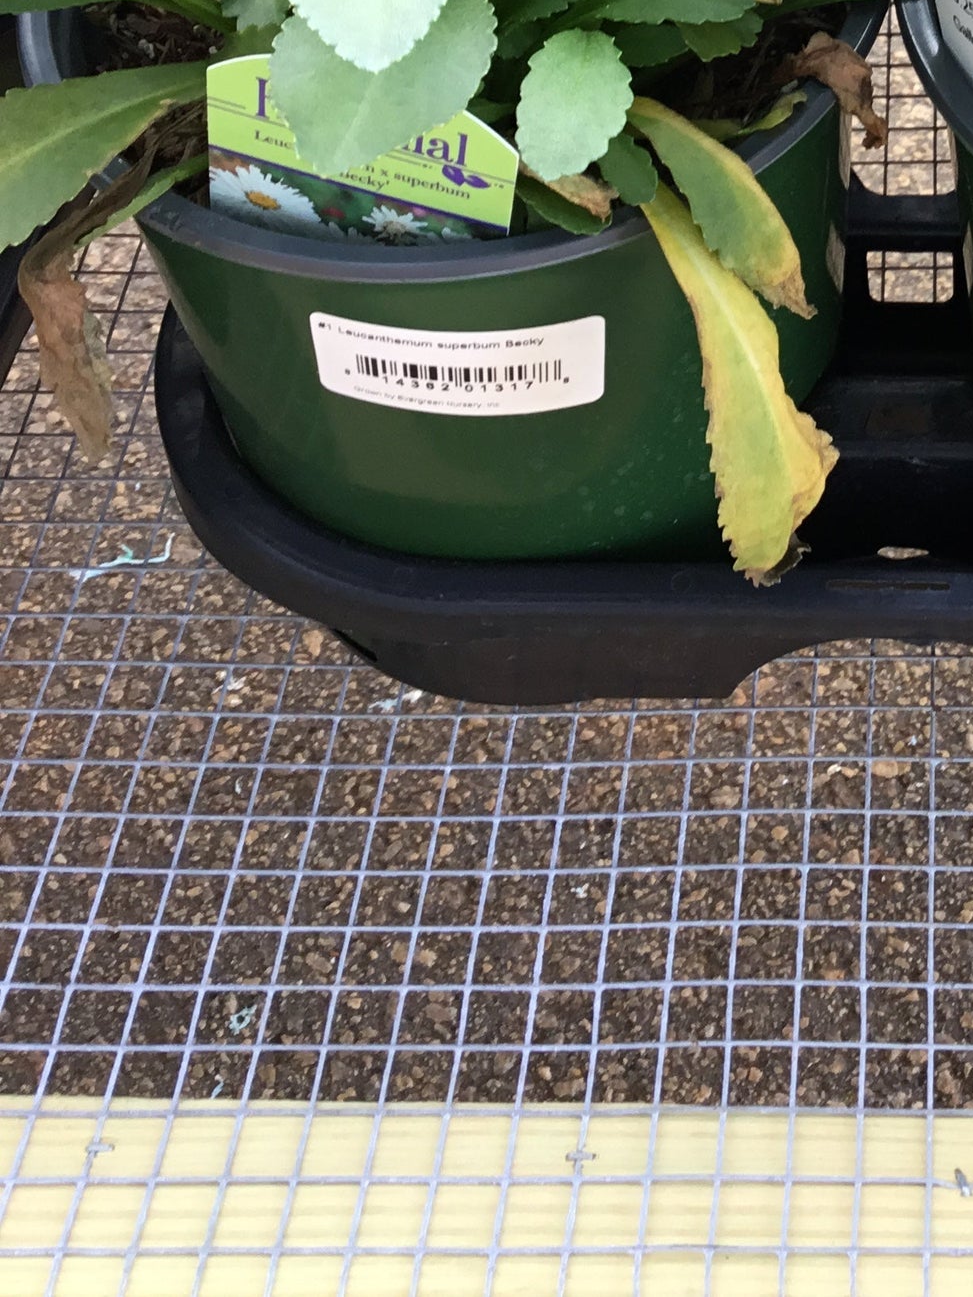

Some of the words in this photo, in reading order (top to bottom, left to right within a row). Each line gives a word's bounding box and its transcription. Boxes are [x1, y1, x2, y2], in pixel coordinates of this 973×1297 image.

[393, 172, 471, 200] superbum
[338, 326, 433, 348] Leucanthemum
[437, 341, 501, 351] superbum
[505, 337, 544, 349] Becky
